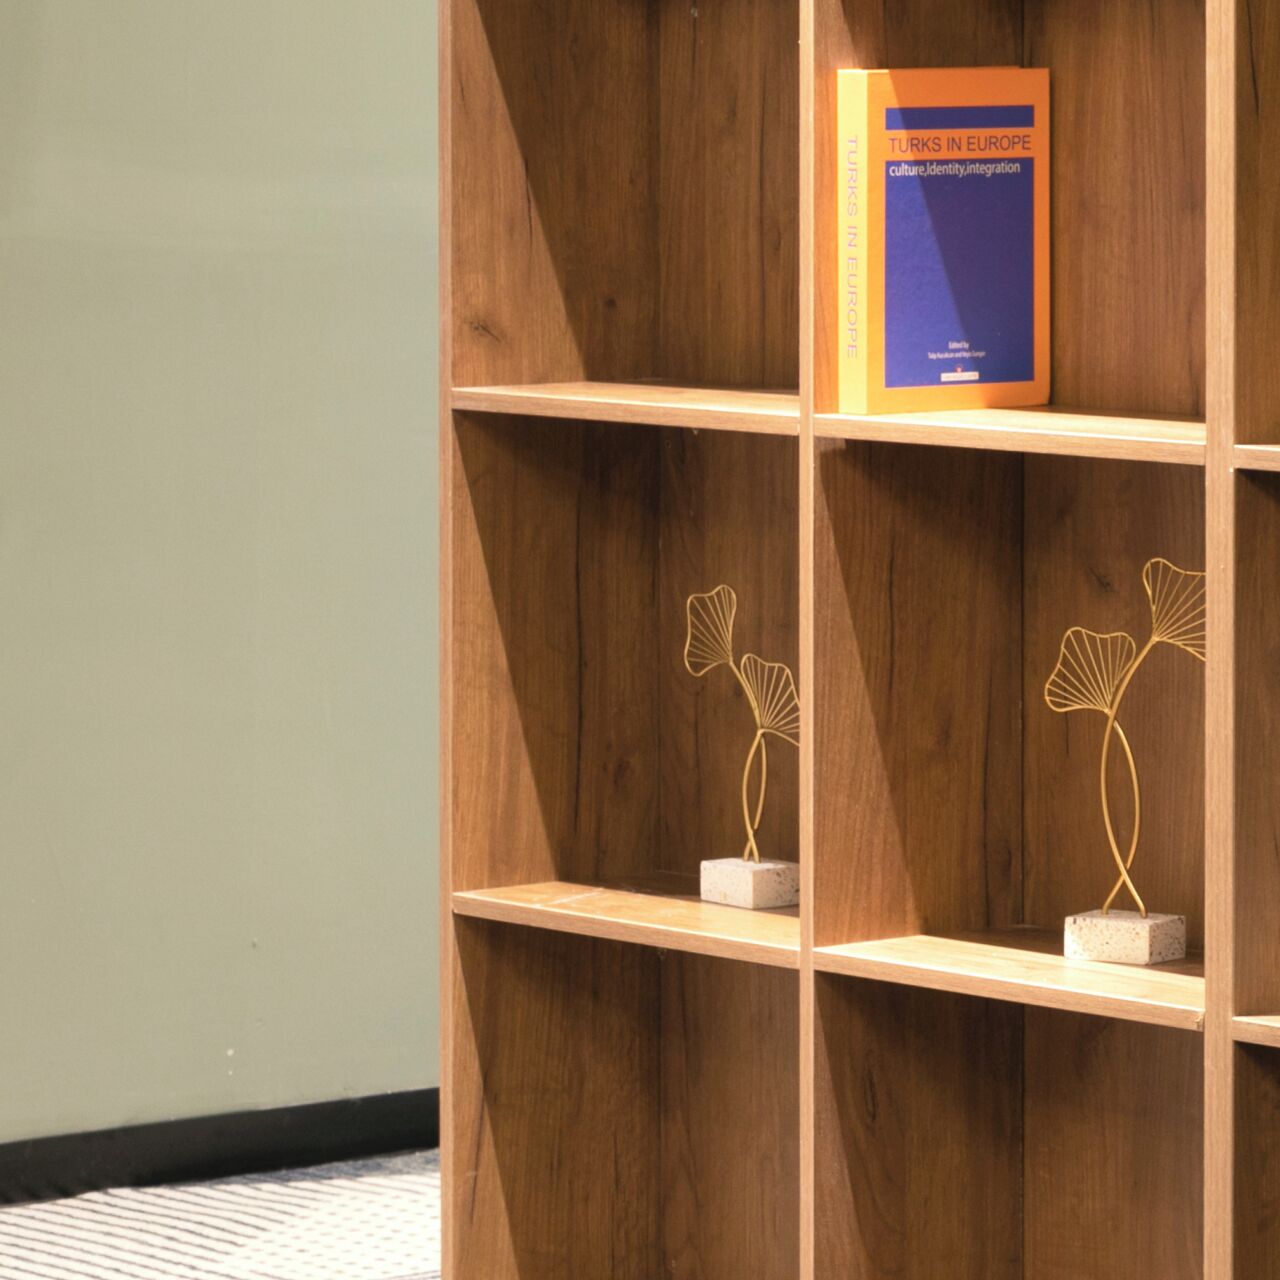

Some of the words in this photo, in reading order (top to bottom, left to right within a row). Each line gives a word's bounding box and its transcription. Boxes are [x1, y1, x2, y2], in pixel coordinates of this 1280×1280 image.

[888, 135, 943, 155] TURKS
[945, 135, 962, 153] IN
[966, 133, 1033, 153] EUROPE
[847, 134, 858, 217] TURKS
[847, 225, 858, 248] IN
[847, 257, 858, 360] EUROPE
